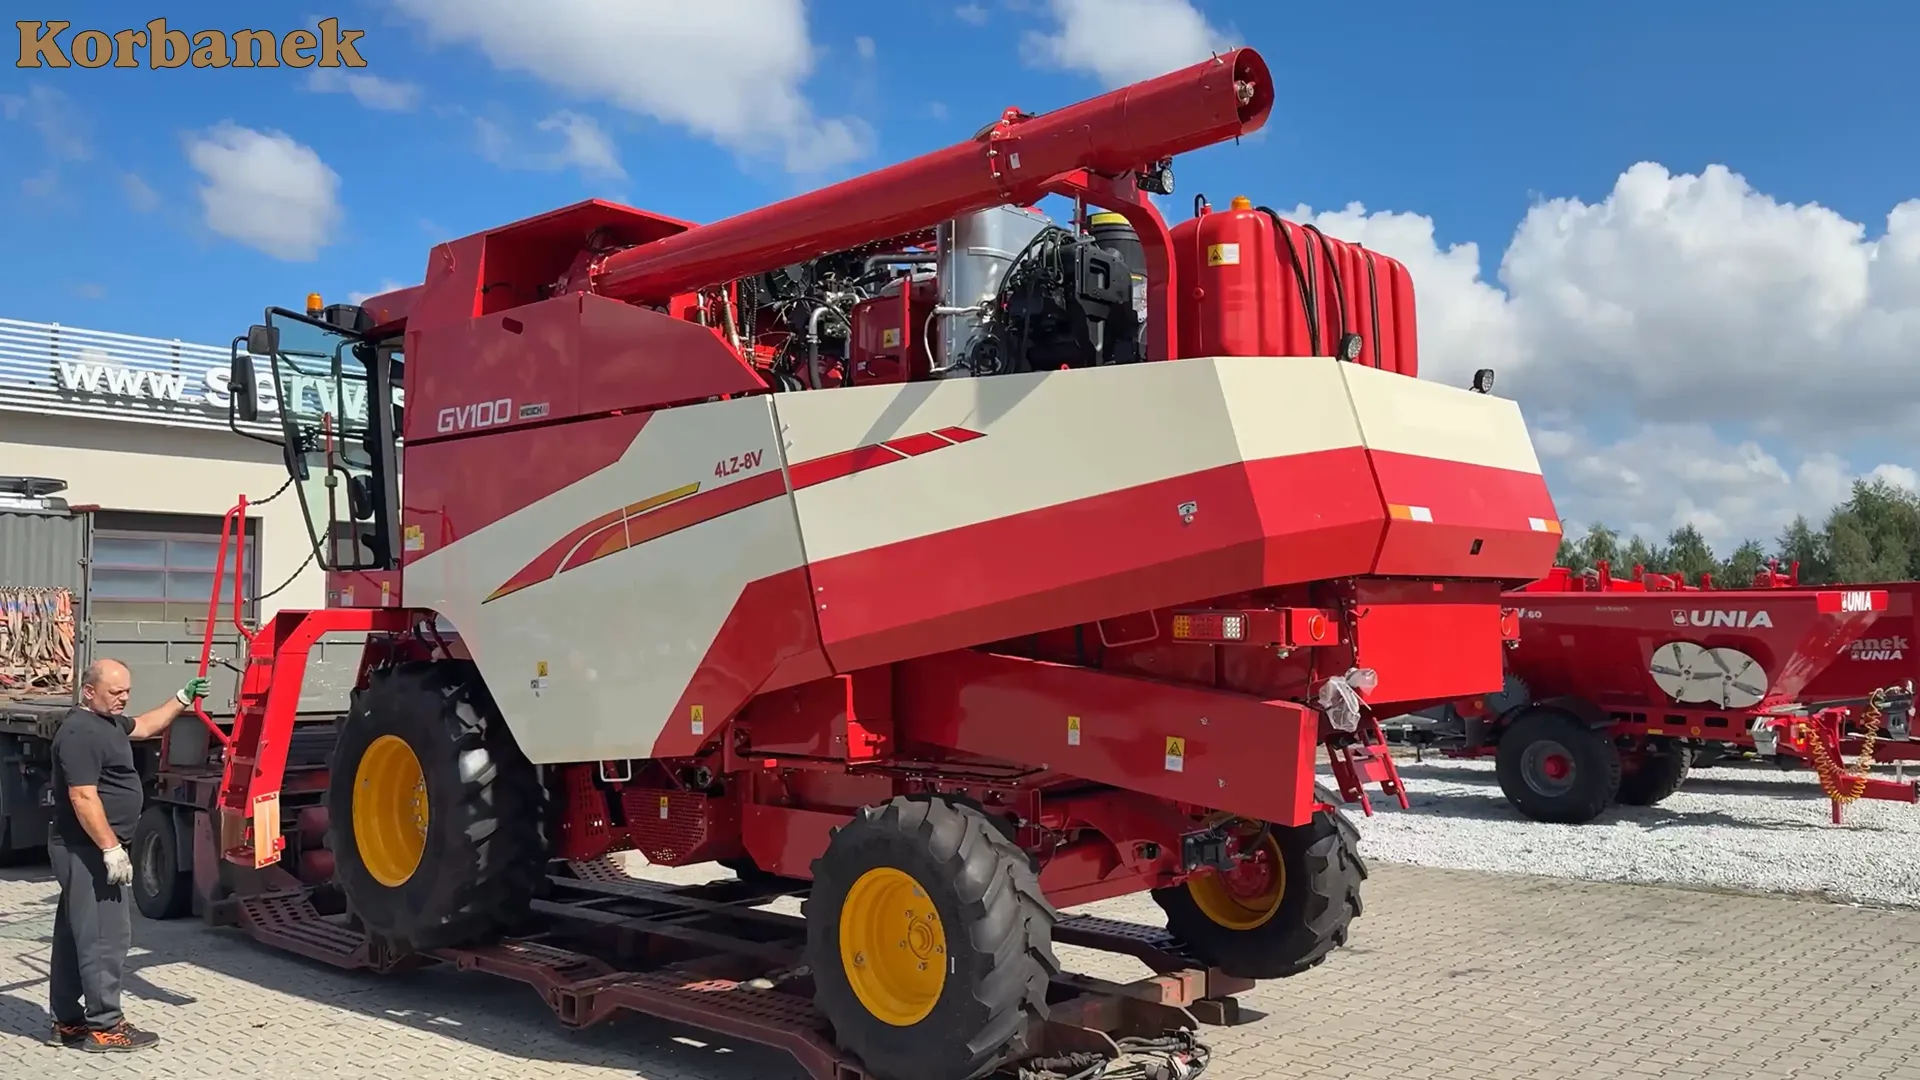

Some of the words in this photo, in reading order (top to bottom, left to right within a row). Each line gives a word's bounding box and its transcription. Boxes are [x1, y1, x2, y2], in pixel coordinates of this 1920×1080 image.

[437, 398, 512, 432] GV100
[714, 448, 763, 478] 4LZ-8V
[1847, 591, 1872, 611] UNIA
[1690, 610, 1774, 628] UNIA
[1846, 635, 1909, 650] anek
[1861, 650, 1903, 660] UNIA
